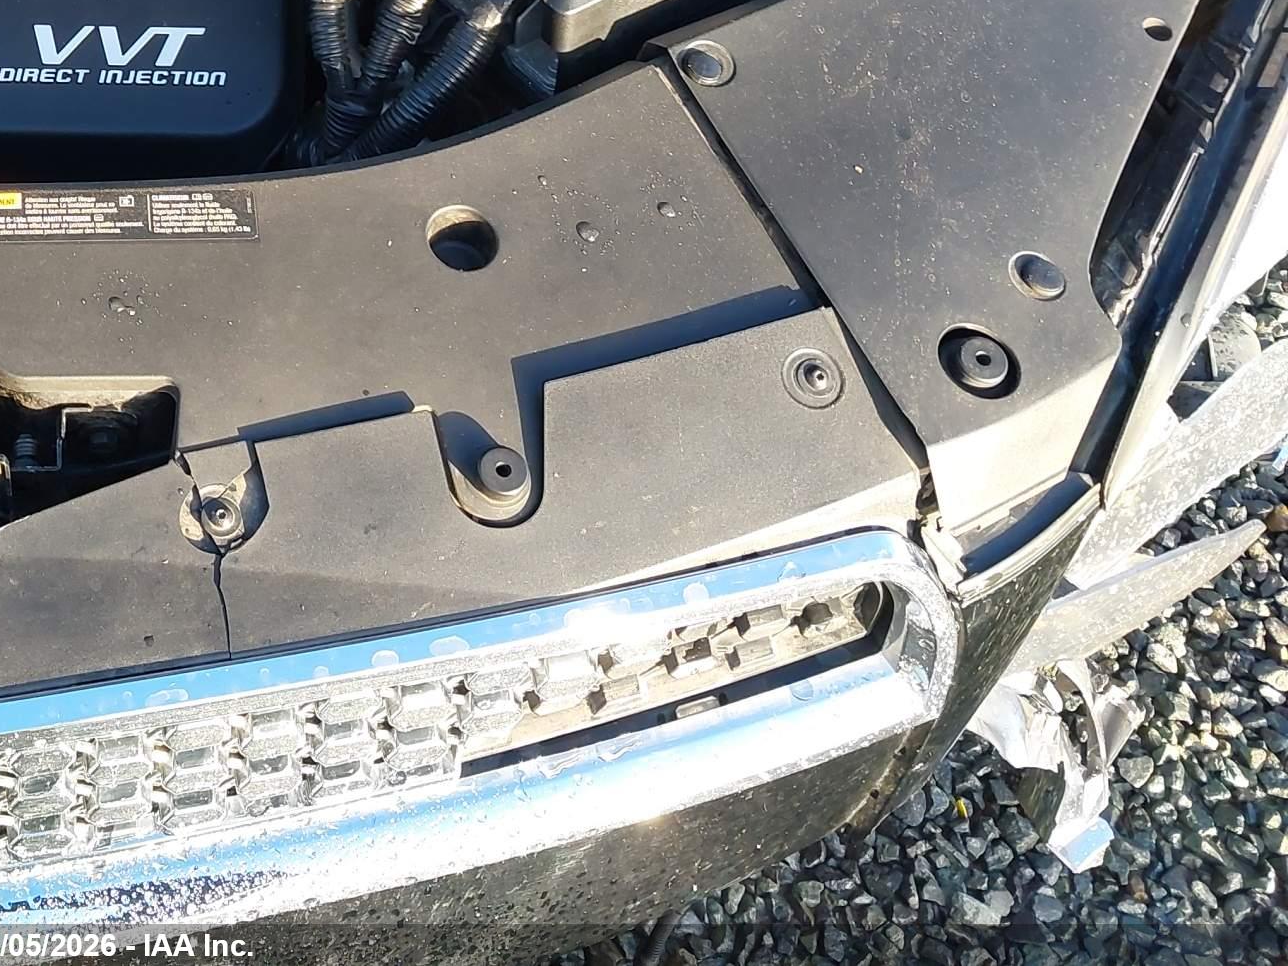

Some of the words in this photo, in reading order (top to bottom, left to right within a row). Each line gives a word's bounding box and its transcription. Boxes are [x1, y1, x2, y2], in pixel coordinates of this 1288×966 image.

[33, 24, 206, 66] VVT
[0, 67, 90, 84] DIRECT
[98, 69, 227, 86] INJECTION
